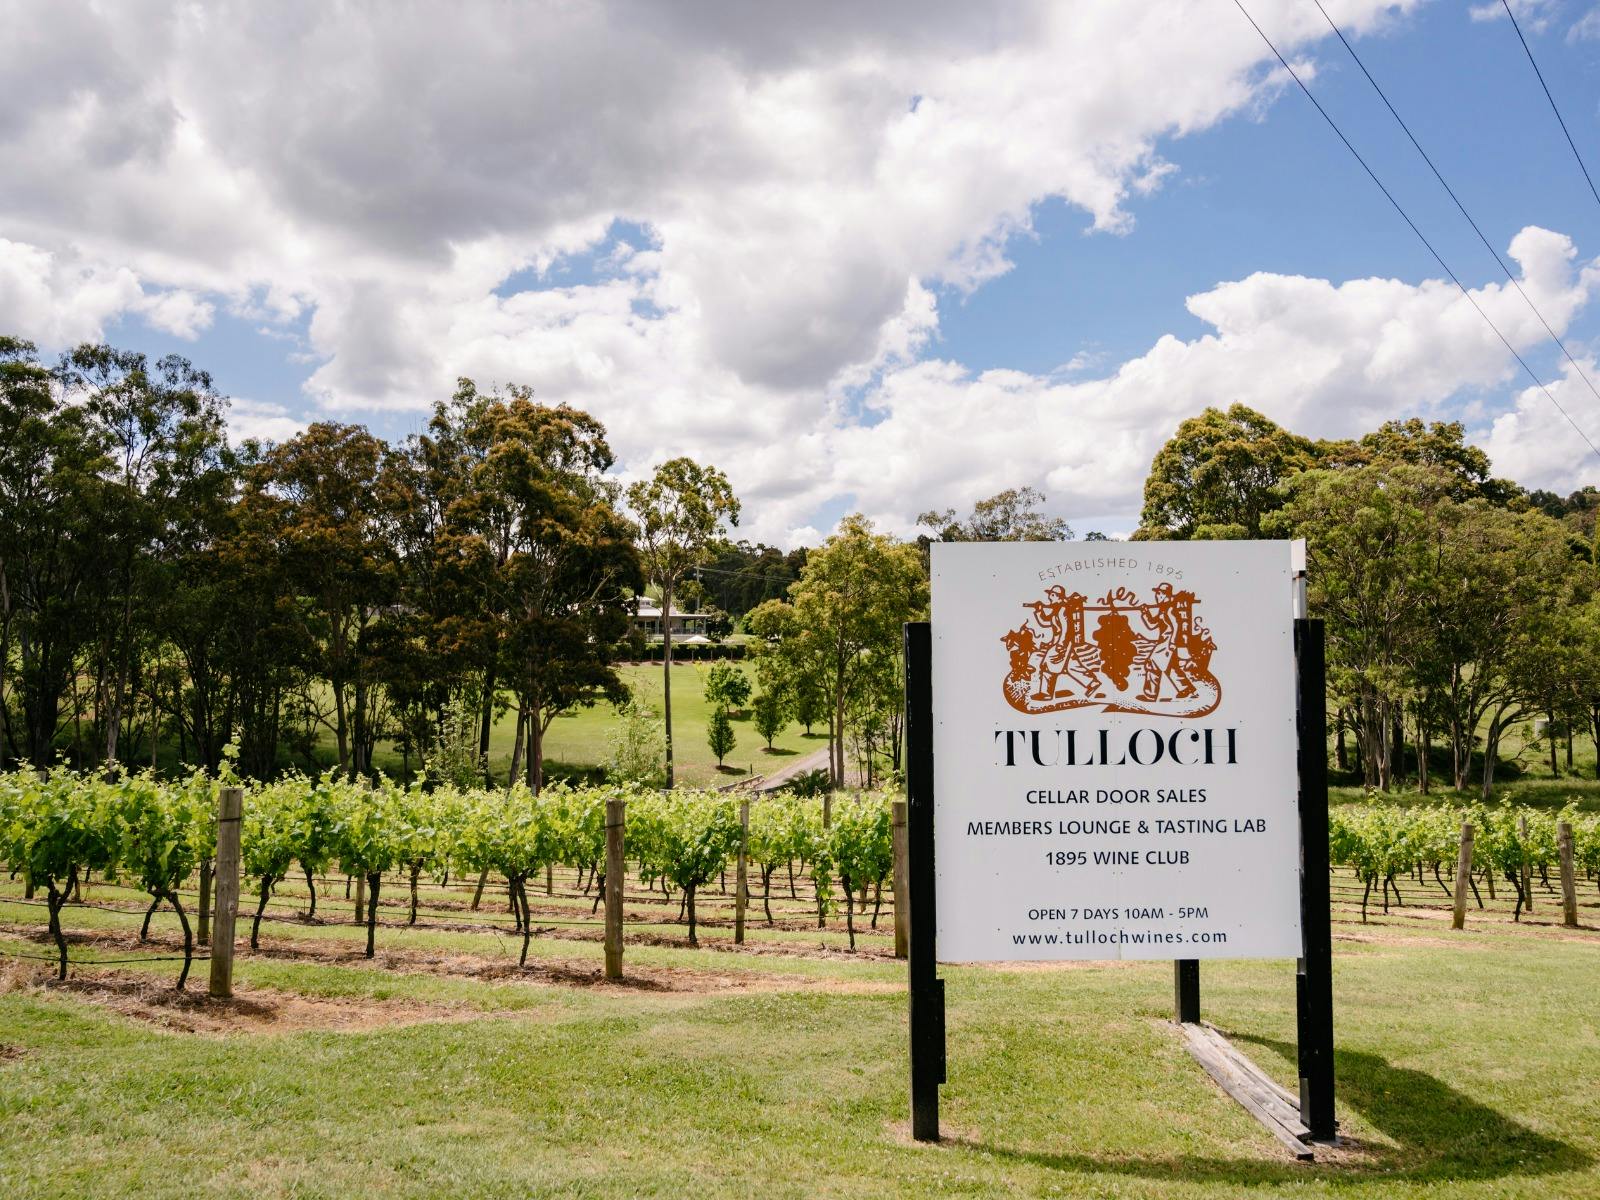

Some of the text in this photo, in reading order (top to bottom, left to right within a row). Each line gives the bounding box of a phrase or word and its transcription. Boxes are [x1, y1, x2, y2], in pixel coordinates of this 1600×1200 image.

[1038, 557, 1184, 582] ESTABLISHED 1895
[995, 728, 1238, 766] TULLOCH
[1026, 789, 1206, 805] CELLAR DOOR SALES
[967, 818, 1266, 835] MEMBERS LOUNGE & TASTING LAB
[1046, 850, 1189, 865] 1895 WINE CLUB
[1028, 908, 1065, 920] OPEN
[1071, 909, 1078, 919] 7
[1084, 908, 1119, 920] DAYS
[1124, 908, 1164, 919] 10AM
[1179, 907, 1208, 918] 5PM
[1012, 930, 1228, 945] www.tullochwines.com
